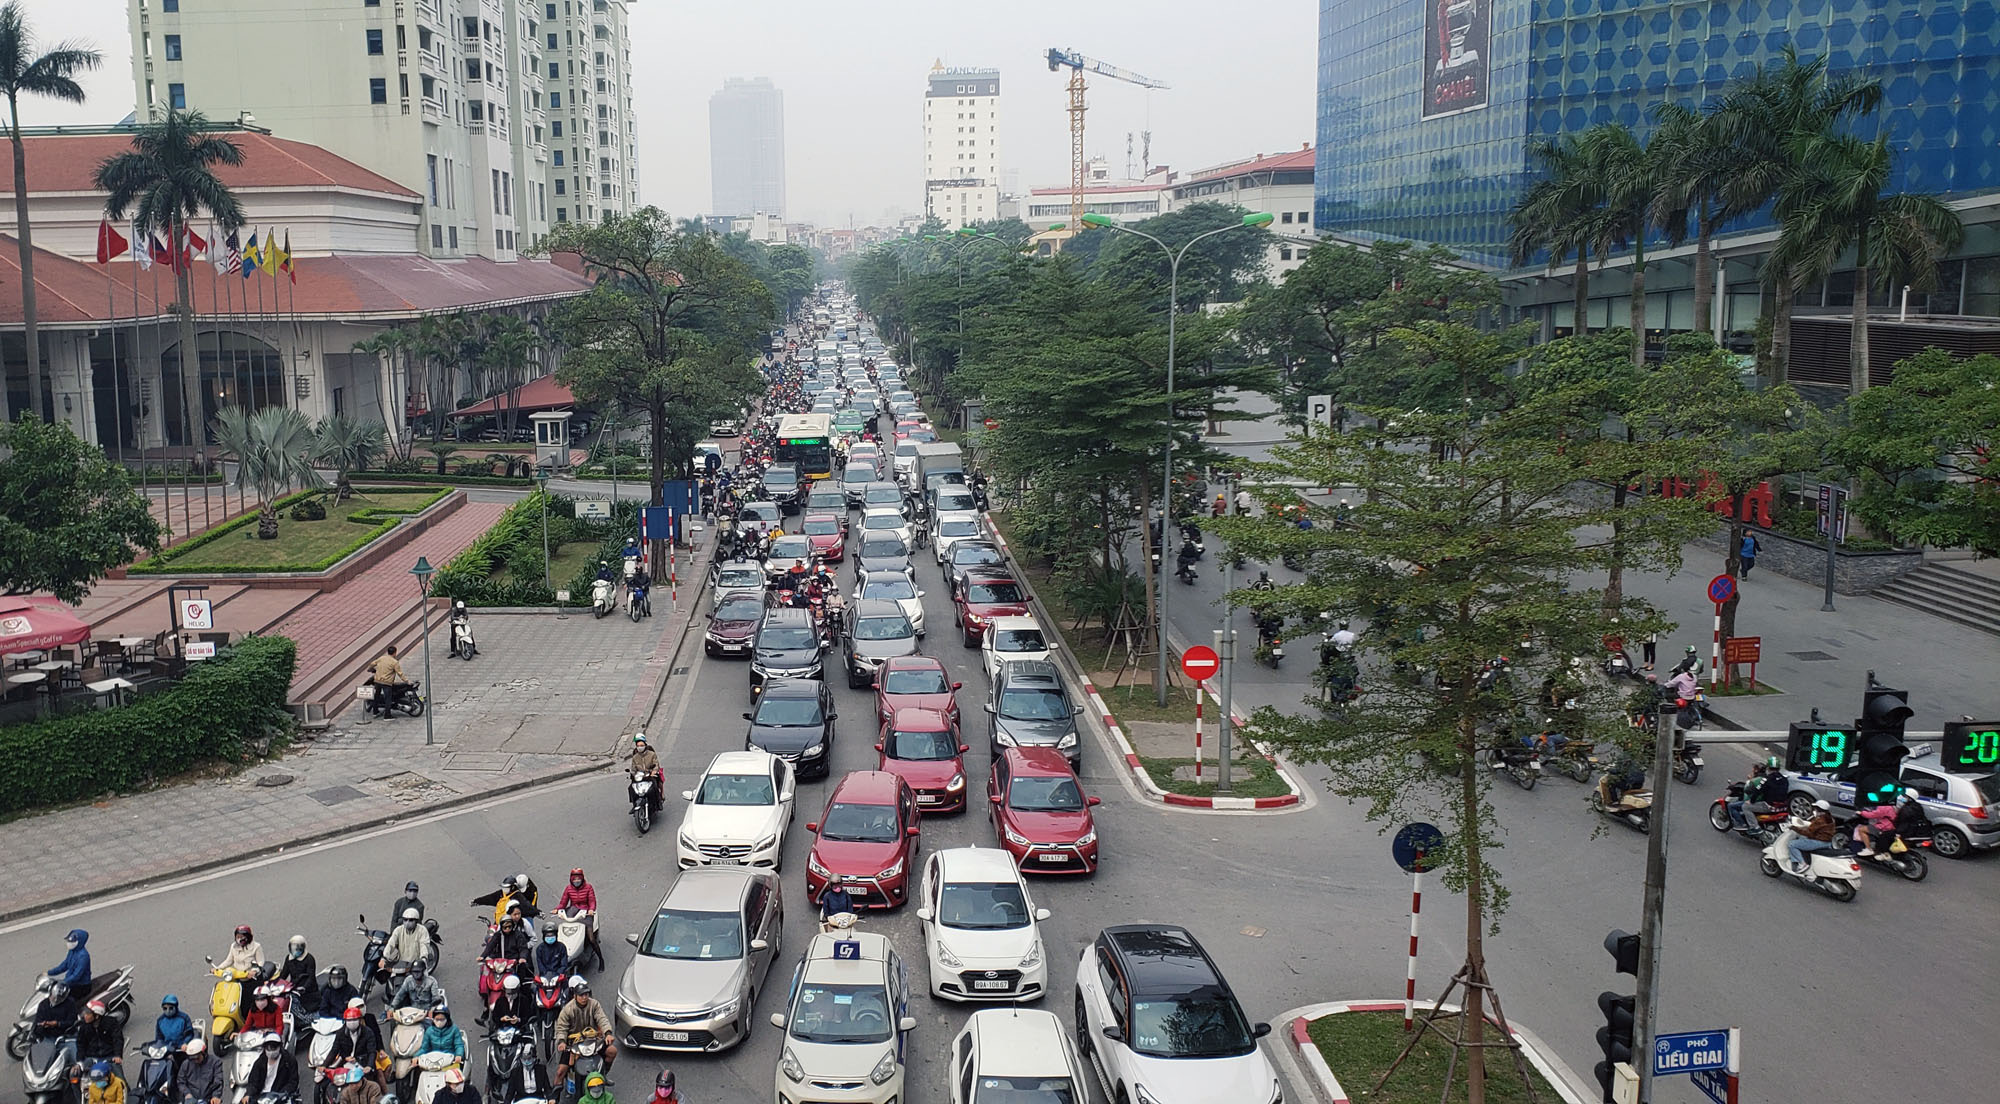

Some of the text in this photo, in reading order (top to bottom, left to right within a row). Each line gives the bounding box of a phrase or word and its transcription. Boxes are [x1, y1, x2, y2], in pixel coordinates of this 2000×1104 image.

[1314, 403, 1326, 418] P
[1810, 731, 1846, 768] 19
[1960, 731, 1999, 764] 20
[839, 944, 854, 958] G7
[1687, 1036, 1708, 1048] PHỐ
[1658, 1050, 1722, 1069] LIỄU GIAI
